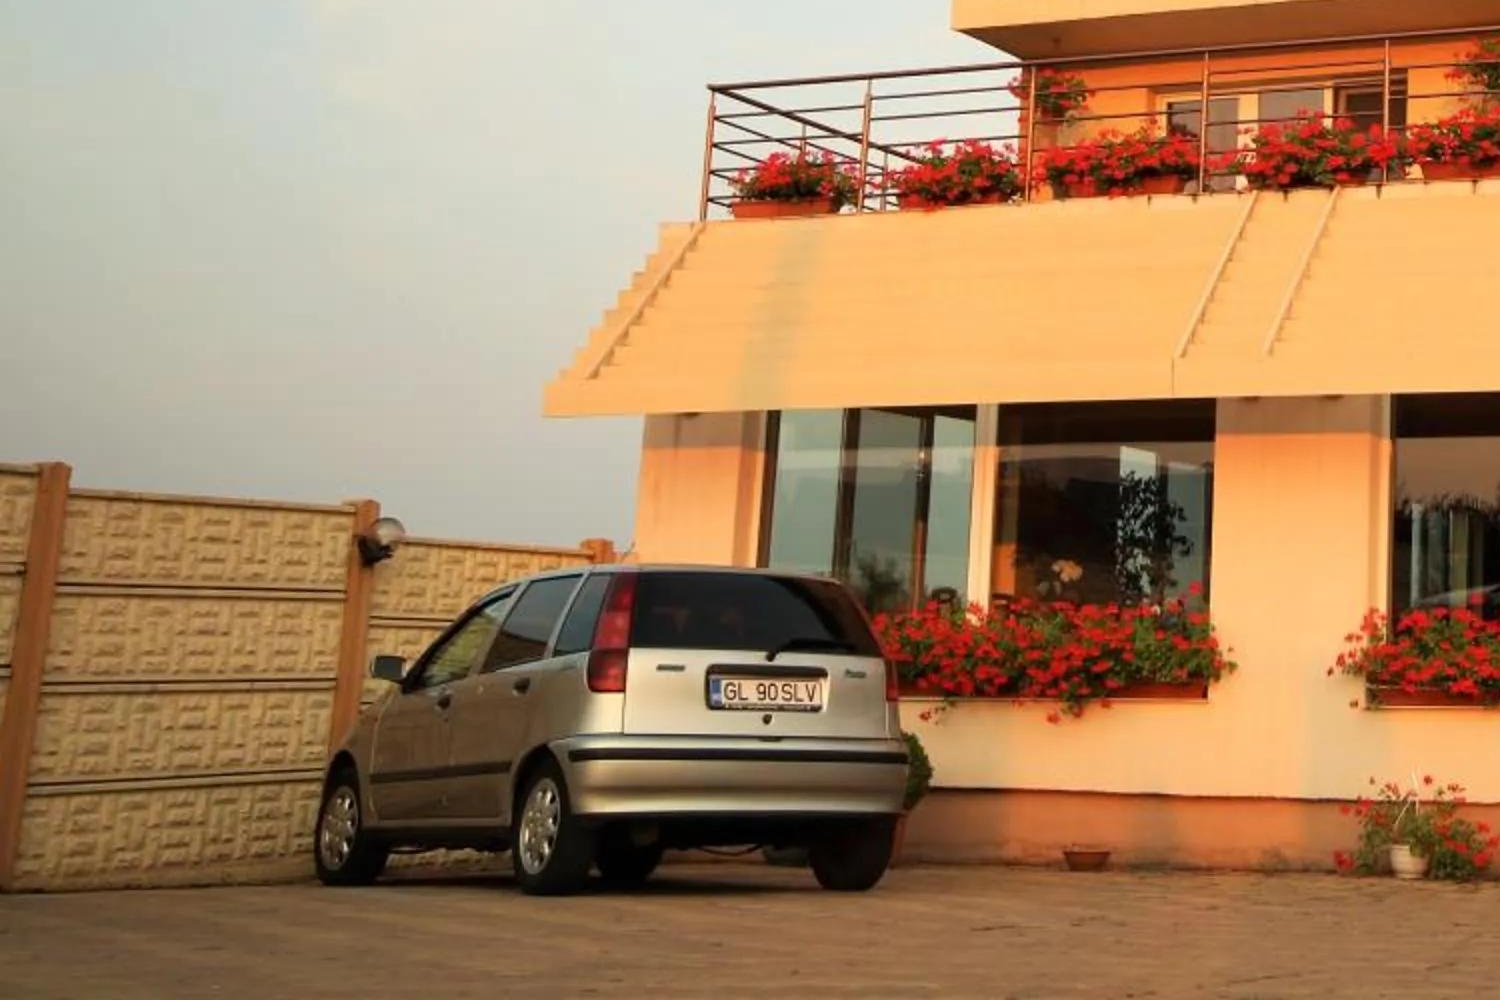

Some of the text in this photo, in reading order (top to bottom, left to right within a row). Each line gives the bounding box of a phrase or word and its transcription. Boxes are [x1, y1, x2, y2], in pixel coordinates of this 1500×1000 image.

[723, 681, 817, 703] GL 90 SLV
